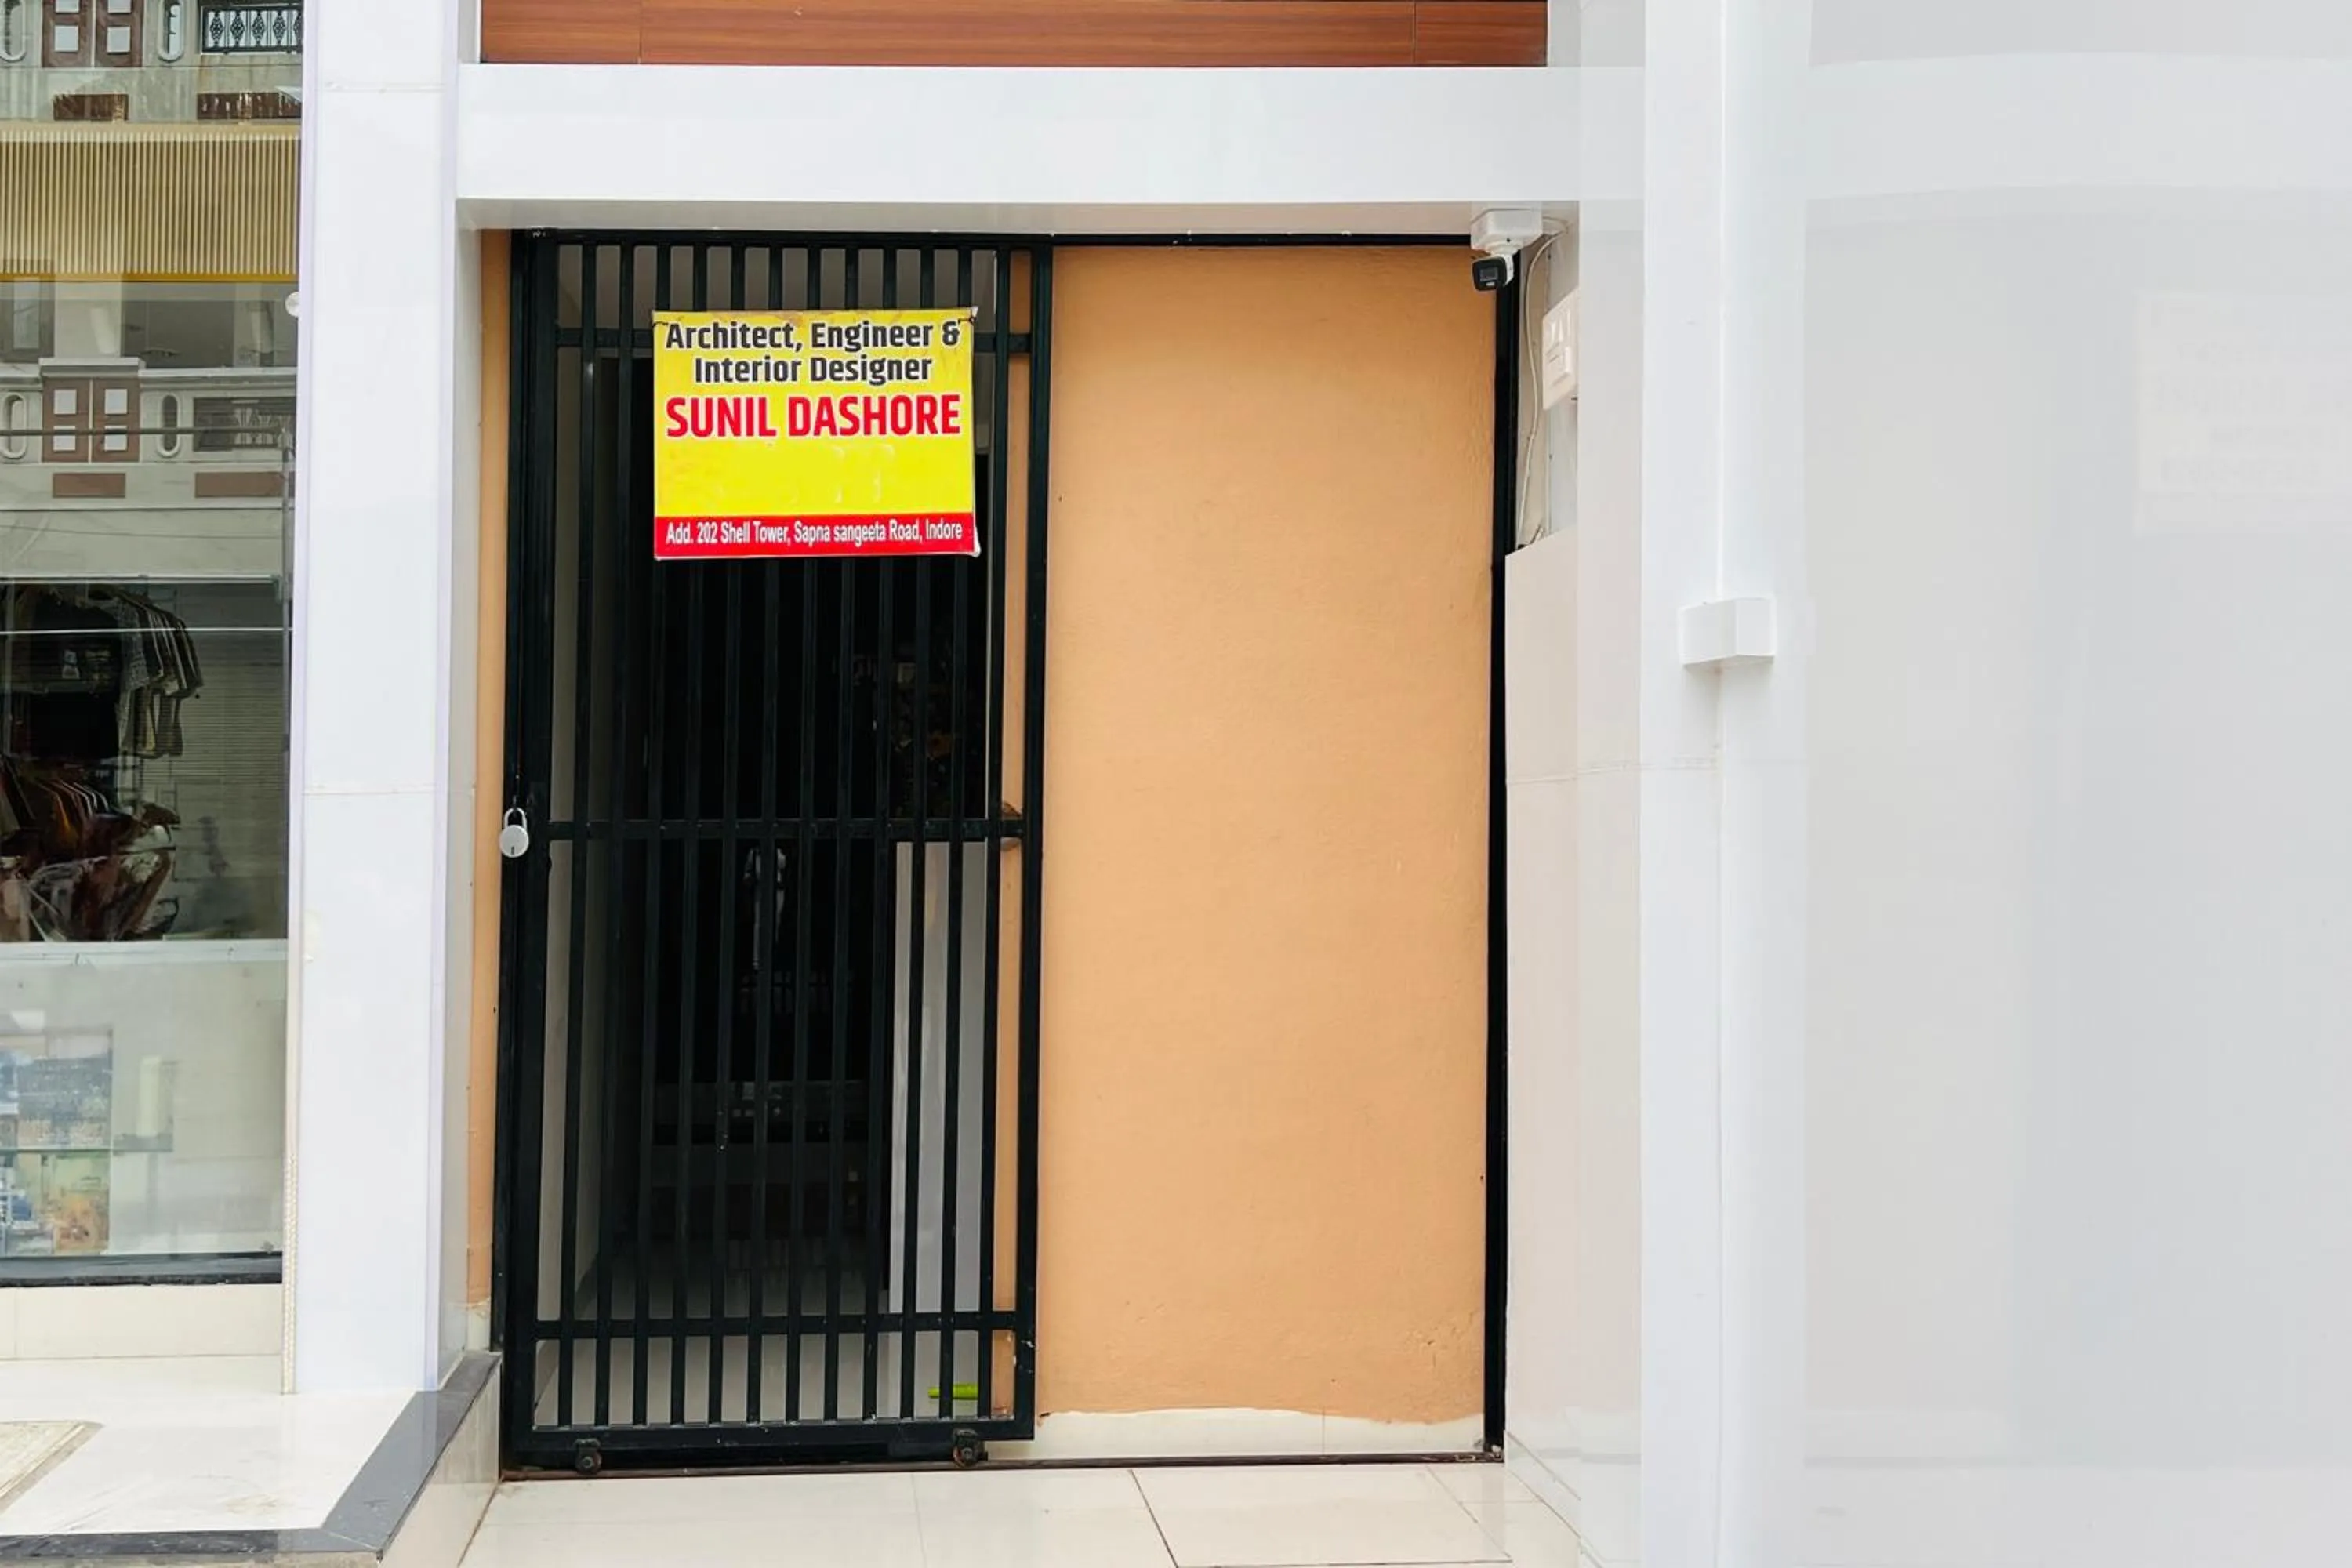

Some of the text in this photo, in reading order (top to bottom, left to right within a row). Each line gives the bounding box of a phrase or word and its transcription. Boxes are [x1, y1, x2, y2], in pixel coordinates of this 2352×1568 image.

[666, 320, 961, 352] Architect, Engineer &
[695, 355, 932, 386] Interior Designer
[666, 394, 961, 437] SUNIL DASHORE
[666, 518, 963, 547] Add. 202 Shell Tower, Sapna sangeeta Road, Indore
